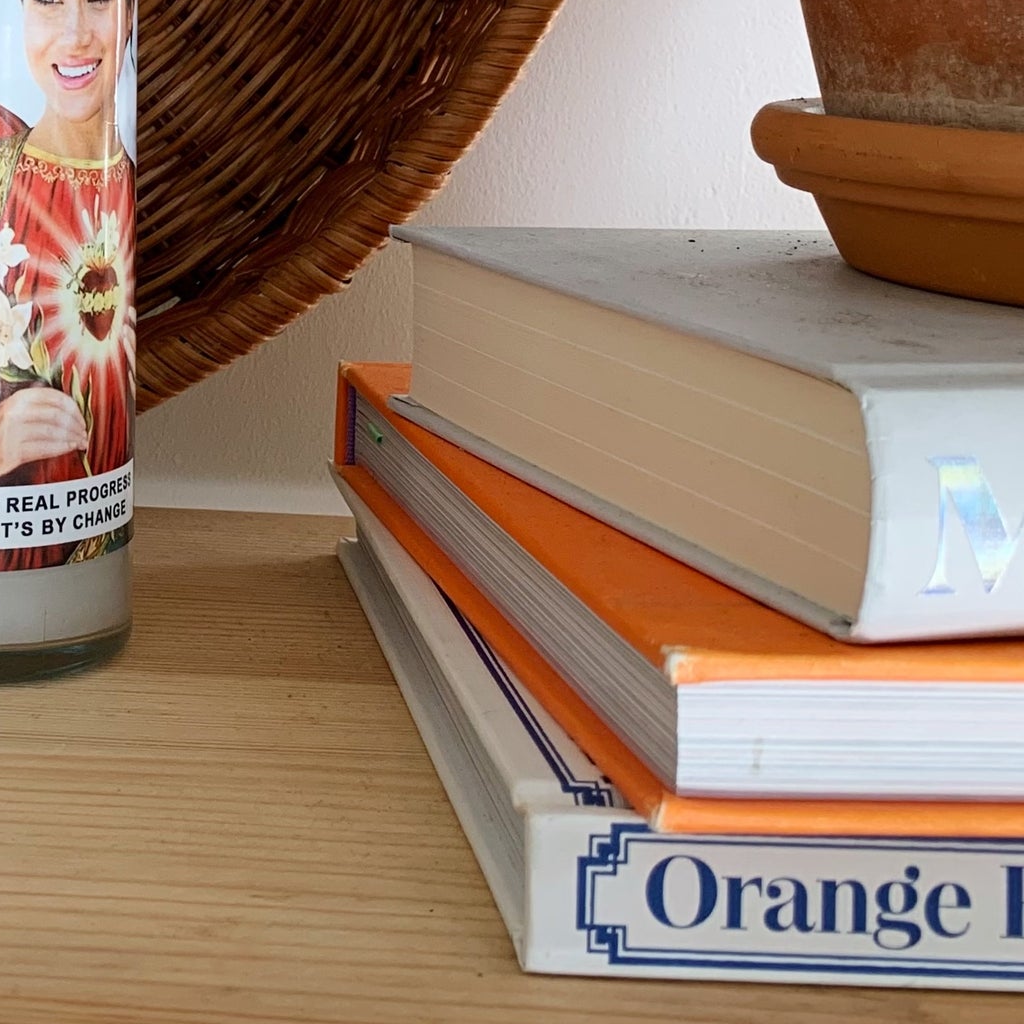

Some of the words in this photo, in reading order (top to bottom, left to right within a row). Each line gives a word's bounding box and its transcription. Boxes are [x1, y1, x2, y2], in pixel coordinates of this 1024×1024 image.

[6, 493, 60, 514] REAL
[67, 471, 131, 507] PROGRESS
[41, 516, 67, 535] BY
[72, 499, 126, 530] CHANGE
[645, 854, 972, 950] Orange
